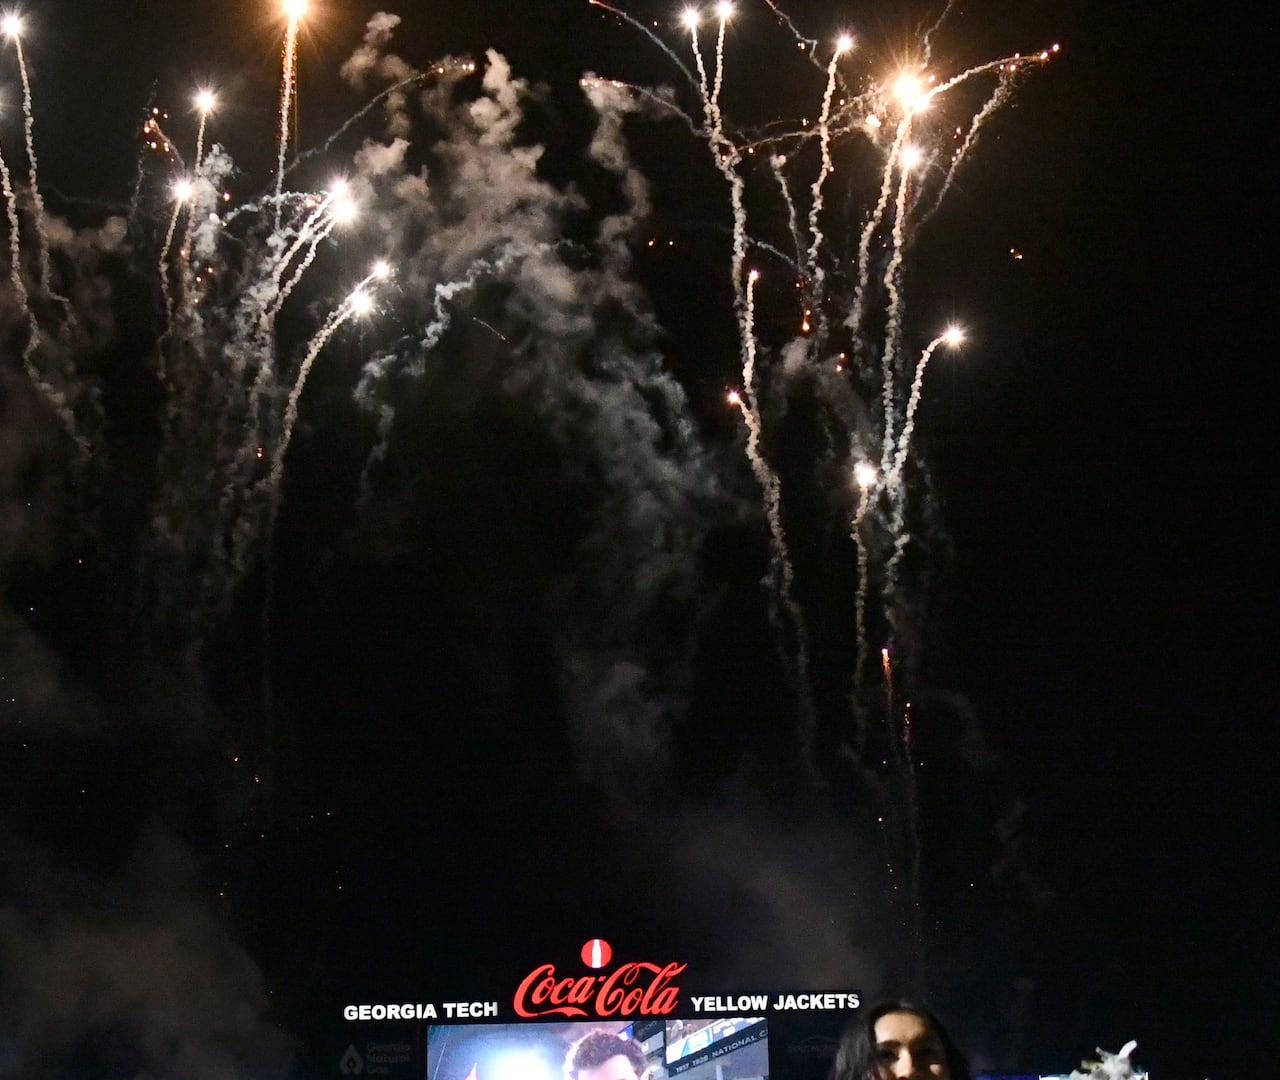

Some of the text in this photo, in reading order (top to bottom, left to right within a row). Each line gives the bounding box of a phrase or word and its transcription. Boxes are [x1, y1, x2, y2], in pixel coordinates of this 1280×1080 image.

[513, 962, 687, 1018] Coca-Cola
[343, 1001, 498, 1020] GEORGIA TECH
[691, 993, 860, 1012] YELLOW JACKETS
[712, 1035, 757, 1058] NATIONAL
